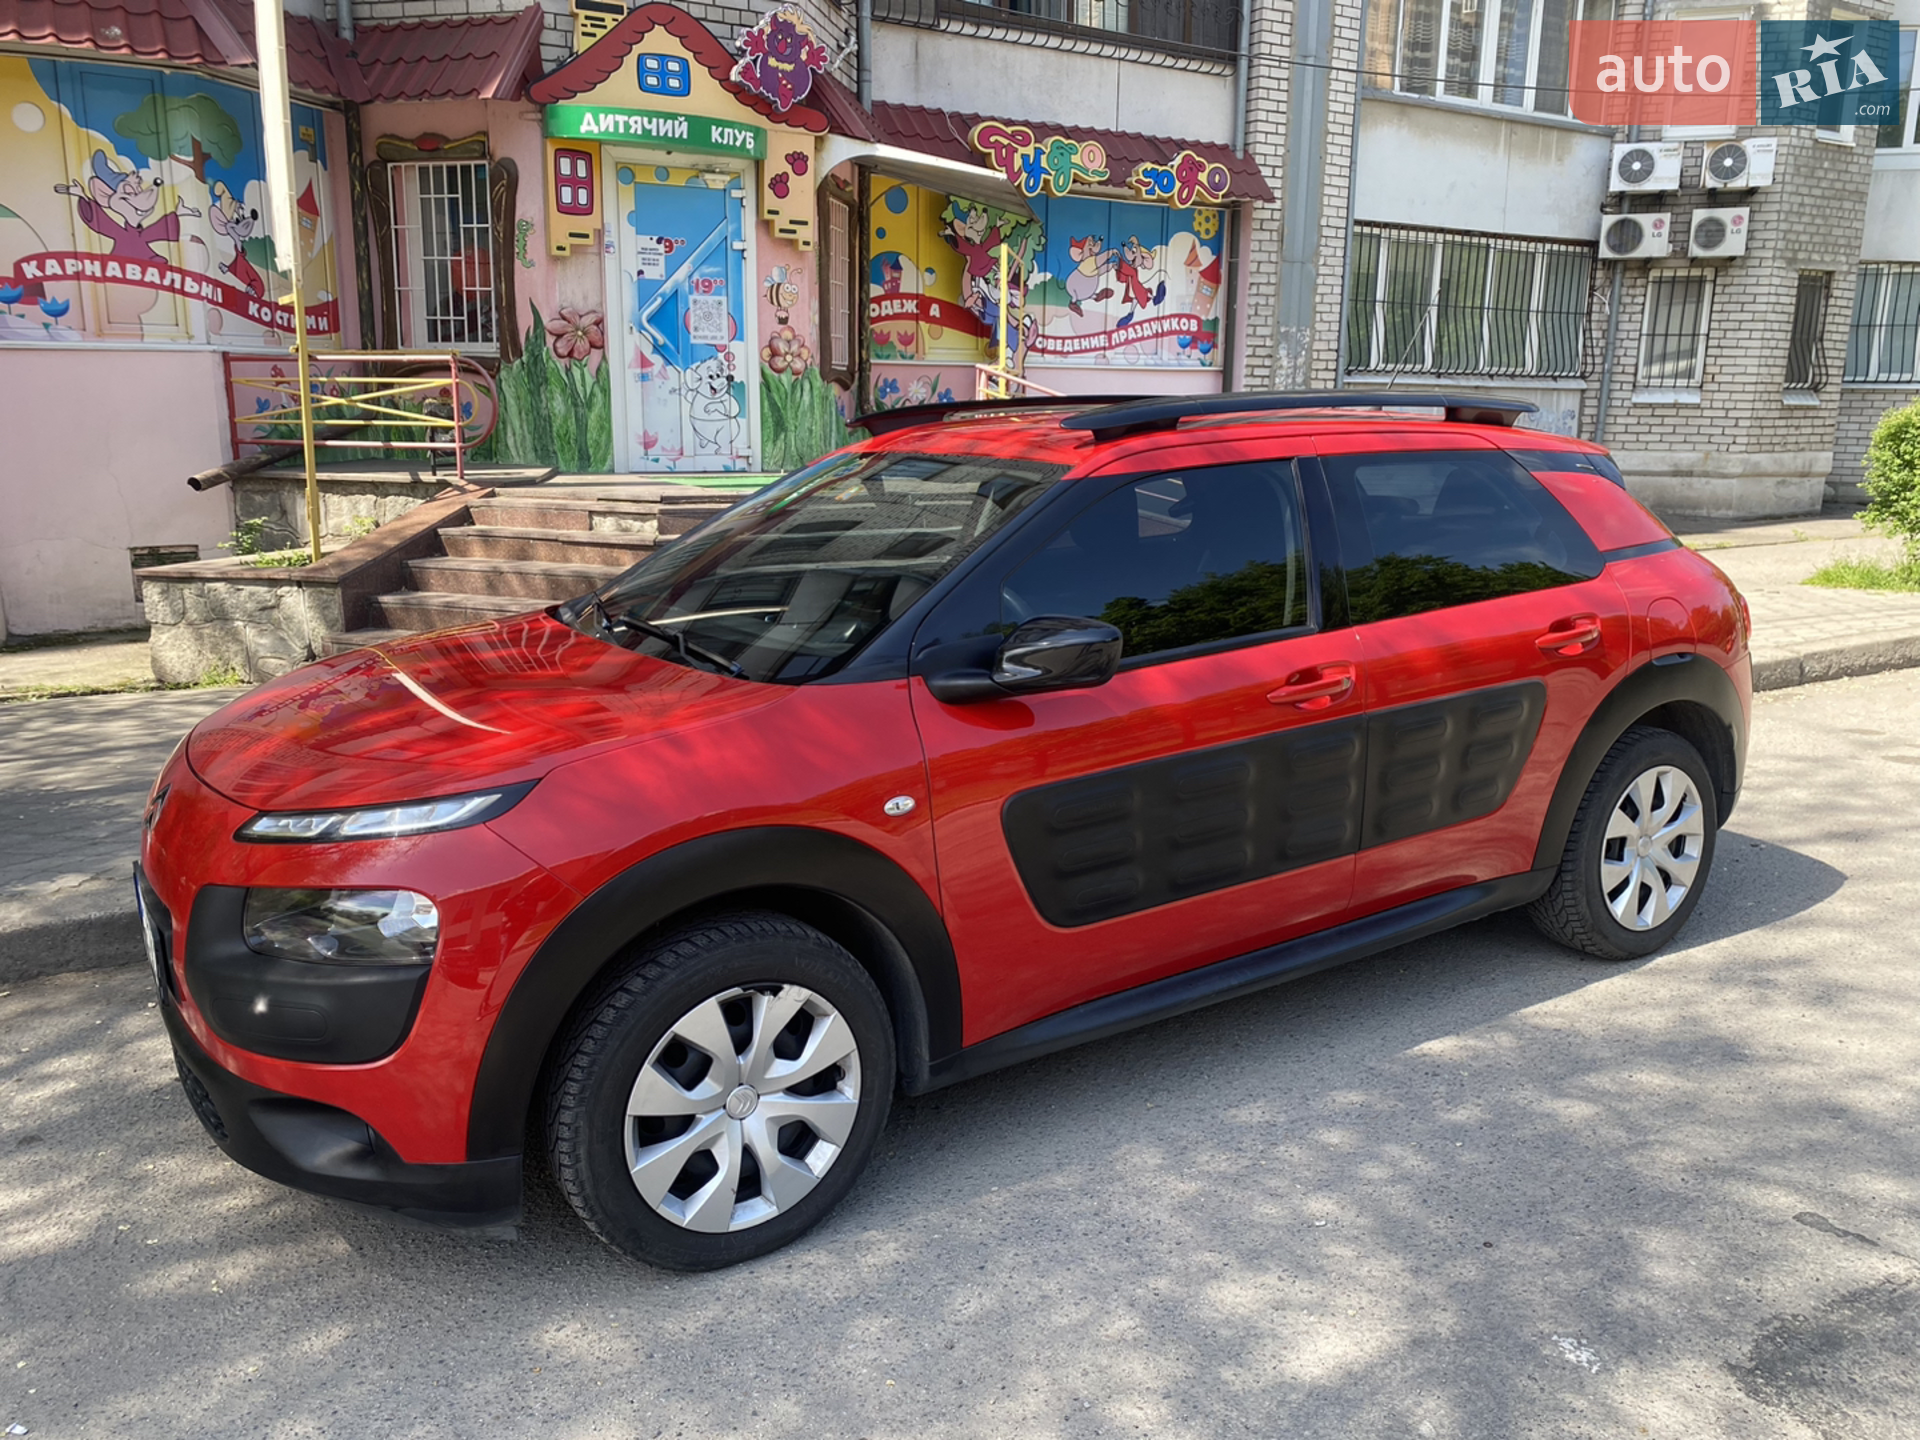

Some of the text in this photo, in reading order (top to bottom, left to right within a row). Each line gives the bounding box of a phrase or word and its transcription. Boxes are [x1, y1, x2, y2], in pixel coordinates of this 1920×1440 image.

[579, 111, 756, 150] ДИТЯЧИЙ КЛУБ
[1035, 334, 1109, 353] ОВЕДЕНИЕ
